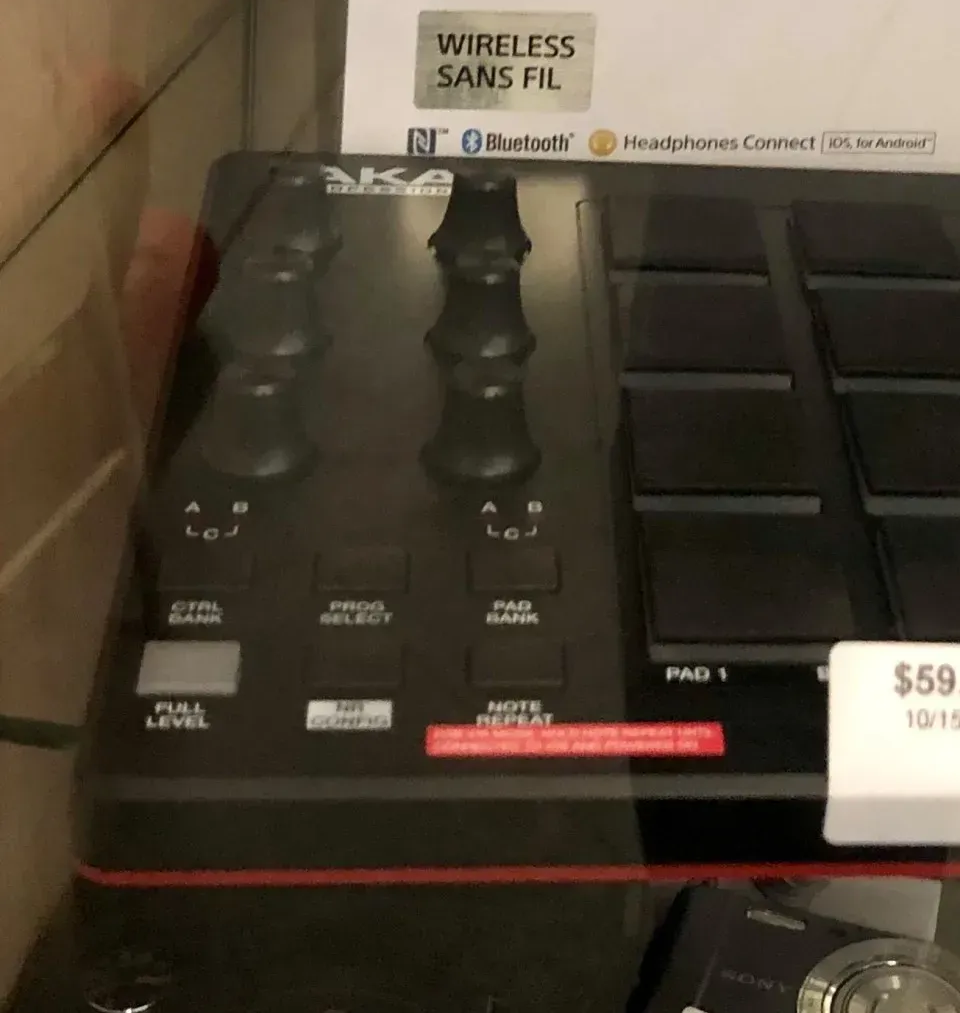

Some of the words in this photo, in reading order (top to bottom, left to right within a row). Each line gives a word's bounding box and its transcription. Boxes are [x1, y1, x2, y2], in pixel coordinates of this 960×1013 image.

[437, 32, 577, 60] WIRELESS
[436, 63, 514, 90] SANS
[522, 65, 562, 91] FIL
[485, 132, 570, 153] Bluetooth
[623, 134, 738, 153] Headphones
[743, 135, 816, 151] Connect
[855, 137, 873, 149] for
[320, 164, 454, 185] AKA
[184, 501, 201, 514] A
[232, 501, 249, 514] B
[480, 501, 498, 514] A
[526, 501, 544, 514] B
[171, 600, 224, 613] CTRL
[328, 600, 386, 613] PROG
[492, 600, 533, 613] PAD
[168, 612, 223, 626] BANK
[319, 612, 393, 626] SELECT
[486, 612, 540, 626] BANK
[665, 666, 711, 683] PAD
[718, 666, 728, 683] 1
[154, 701, 207, 714] FULL
[487, 700, 543, 713] NOTE
[146, 715, 211, 730] LEVEL
[475, 713, 555, 726] REPEAT
